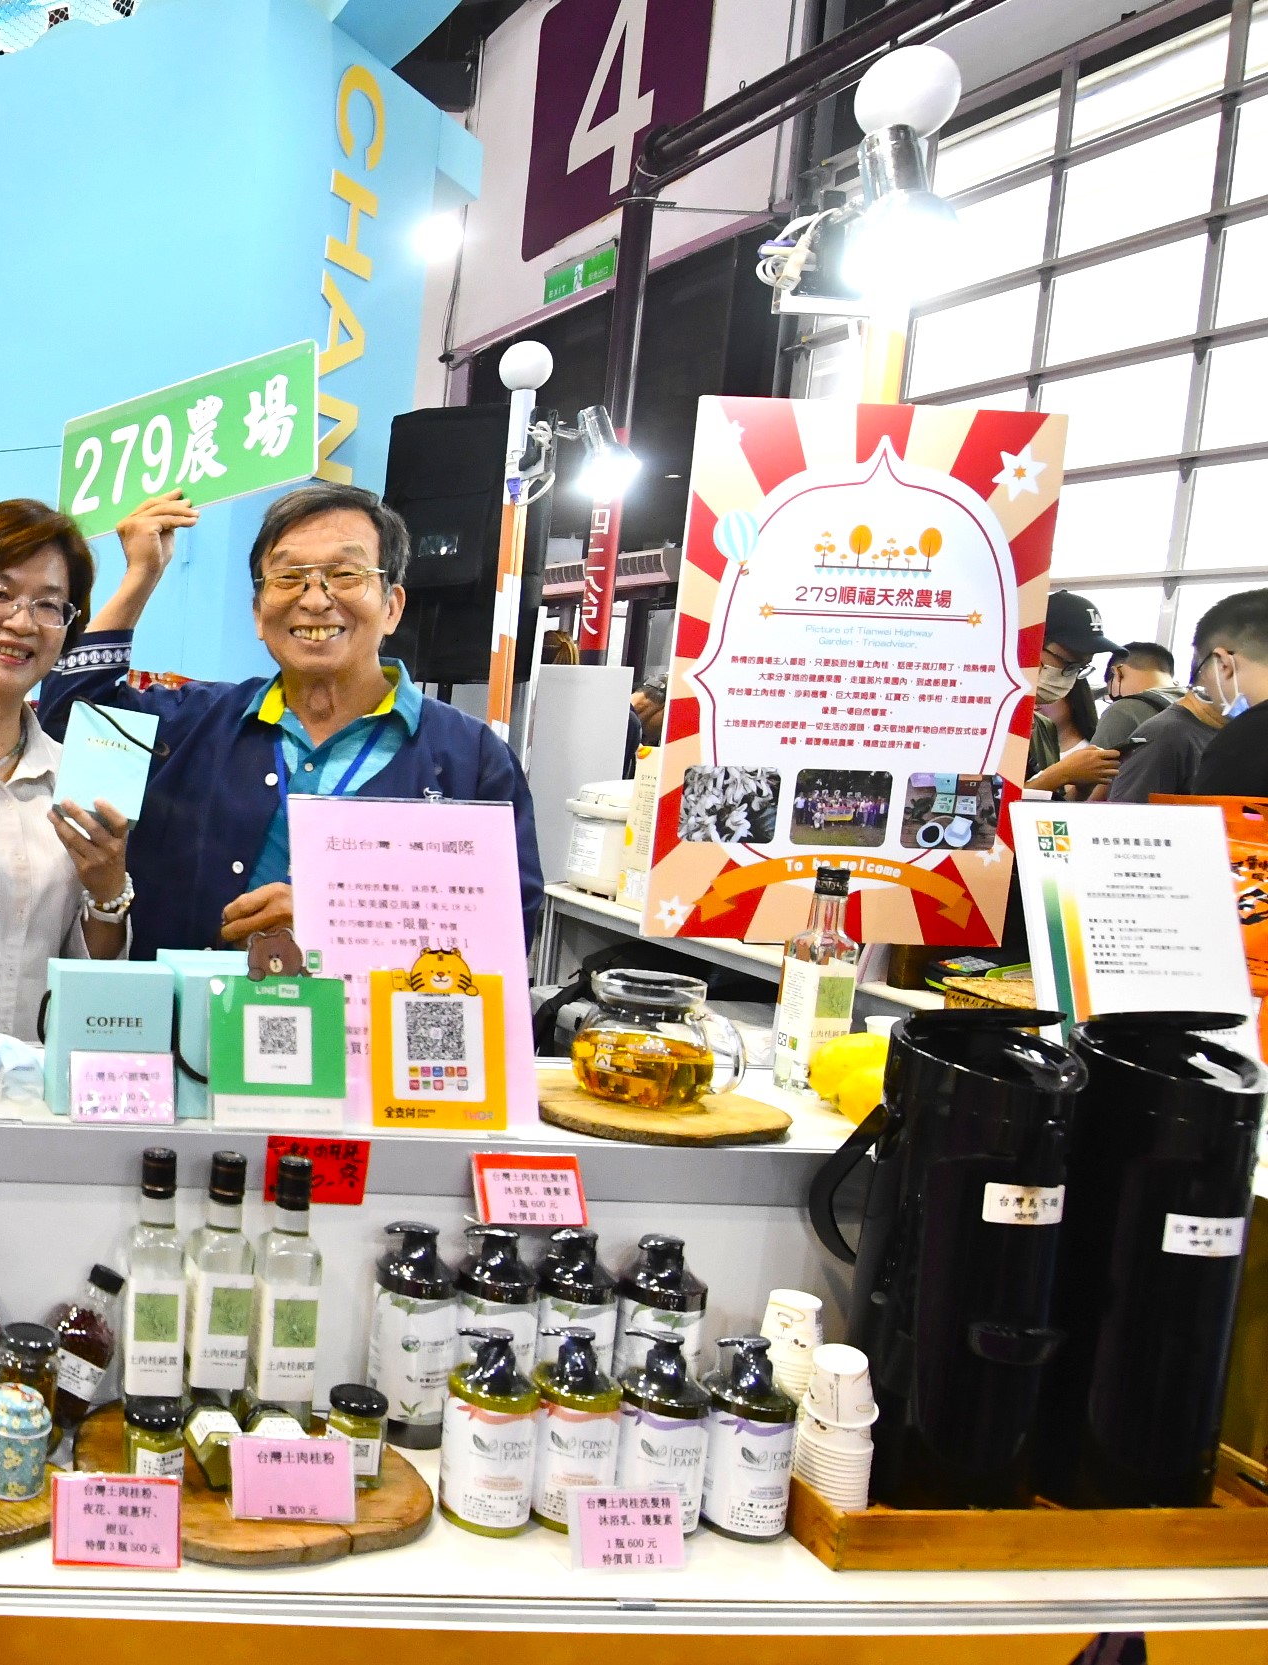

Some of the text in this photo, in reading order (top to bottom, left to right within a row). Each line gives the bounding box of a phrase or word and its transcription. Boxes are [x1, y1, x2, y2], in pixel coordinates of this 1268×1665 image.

[566, 0, 656, 197] 4
[548, 284, 567, 299] EXIT
[70, 373, 299, 518] 279農場
[794, 585, 953, 609] 279順福天然農場
[805, 624, 933, 639] Picture of Tianwei Highway
[818, 637, 853, 647] Garden
[786, 859, 804, 872] To
[839, 859, 902, 878] welcome
[86, 1016, 144, 1028] COFFEE
[384, 1106, 416, 1119] 全支付
[256, 1451, 335, 1465] 台灣土肉桂粉
[277, 1505, 287, 1515] 瓶
[290, 1505, 306, 1515] 200
[308, 1505, 318, 1515] 元
[586, 1497, 672, 1510] 台灣土肉桂洗髮精
[598, 1514, 673, 1527] 沐浴乳、護髮素
[85, 1539, 106, 1551] 特價
[118, 1542, 128, 1553] 瓶
[150, 1543, 161, 1555] 元
[615, 1538, 625, 1549] 瓶
[628, 1538, 644, 1548] 600
[647, 1538, 658, 1549] 元
[602, 1553, 633, 1565] 特價買
[645, 1553, 655, 1565] 送
